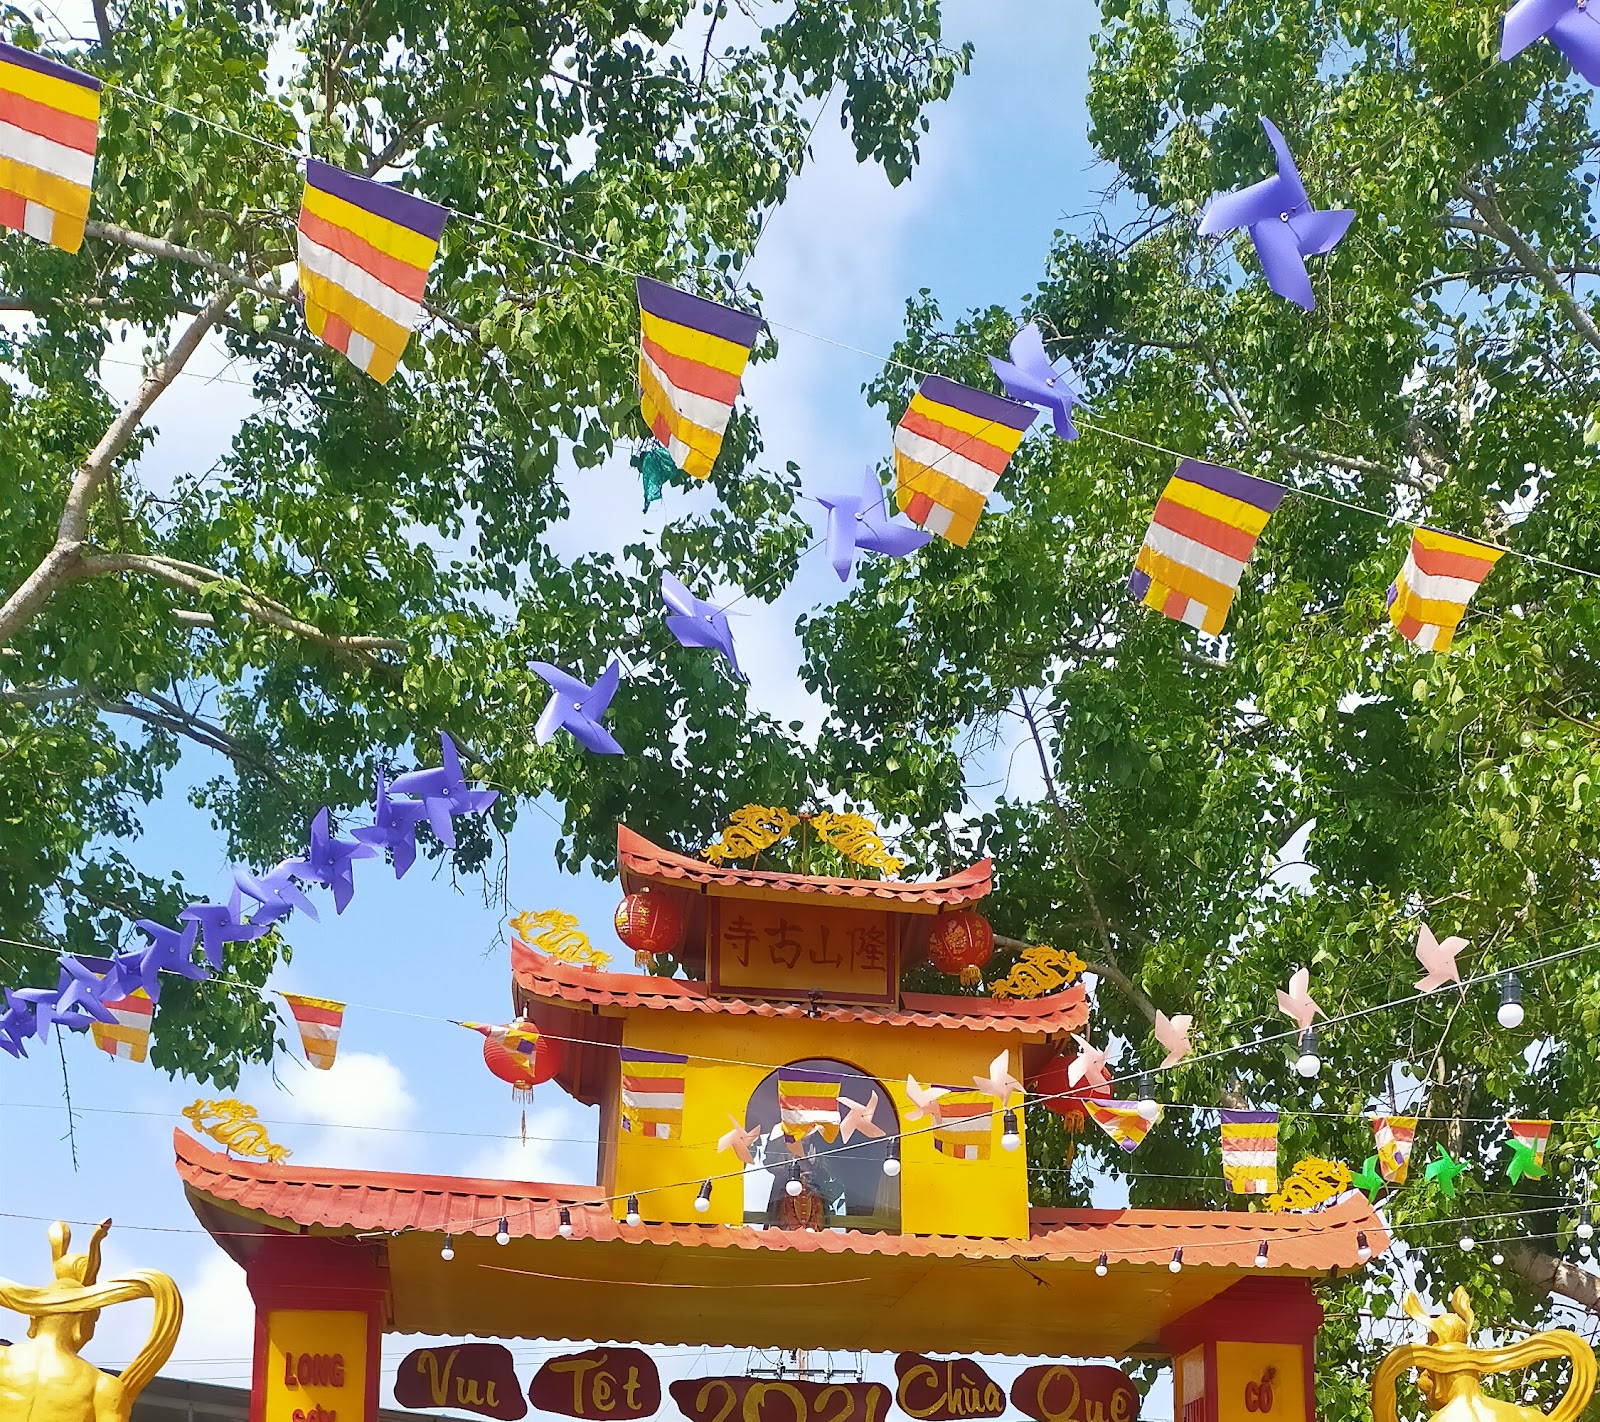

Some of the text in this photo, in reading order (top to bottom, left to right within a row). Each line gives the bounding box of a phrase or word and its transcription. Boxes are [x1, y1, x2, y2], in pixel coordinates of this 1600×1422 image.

[284, 1352, 344, 1388] LONG
[417, 1349, 500, 1408] Vui
[900, 1361, 1003, 1418] Chùa
